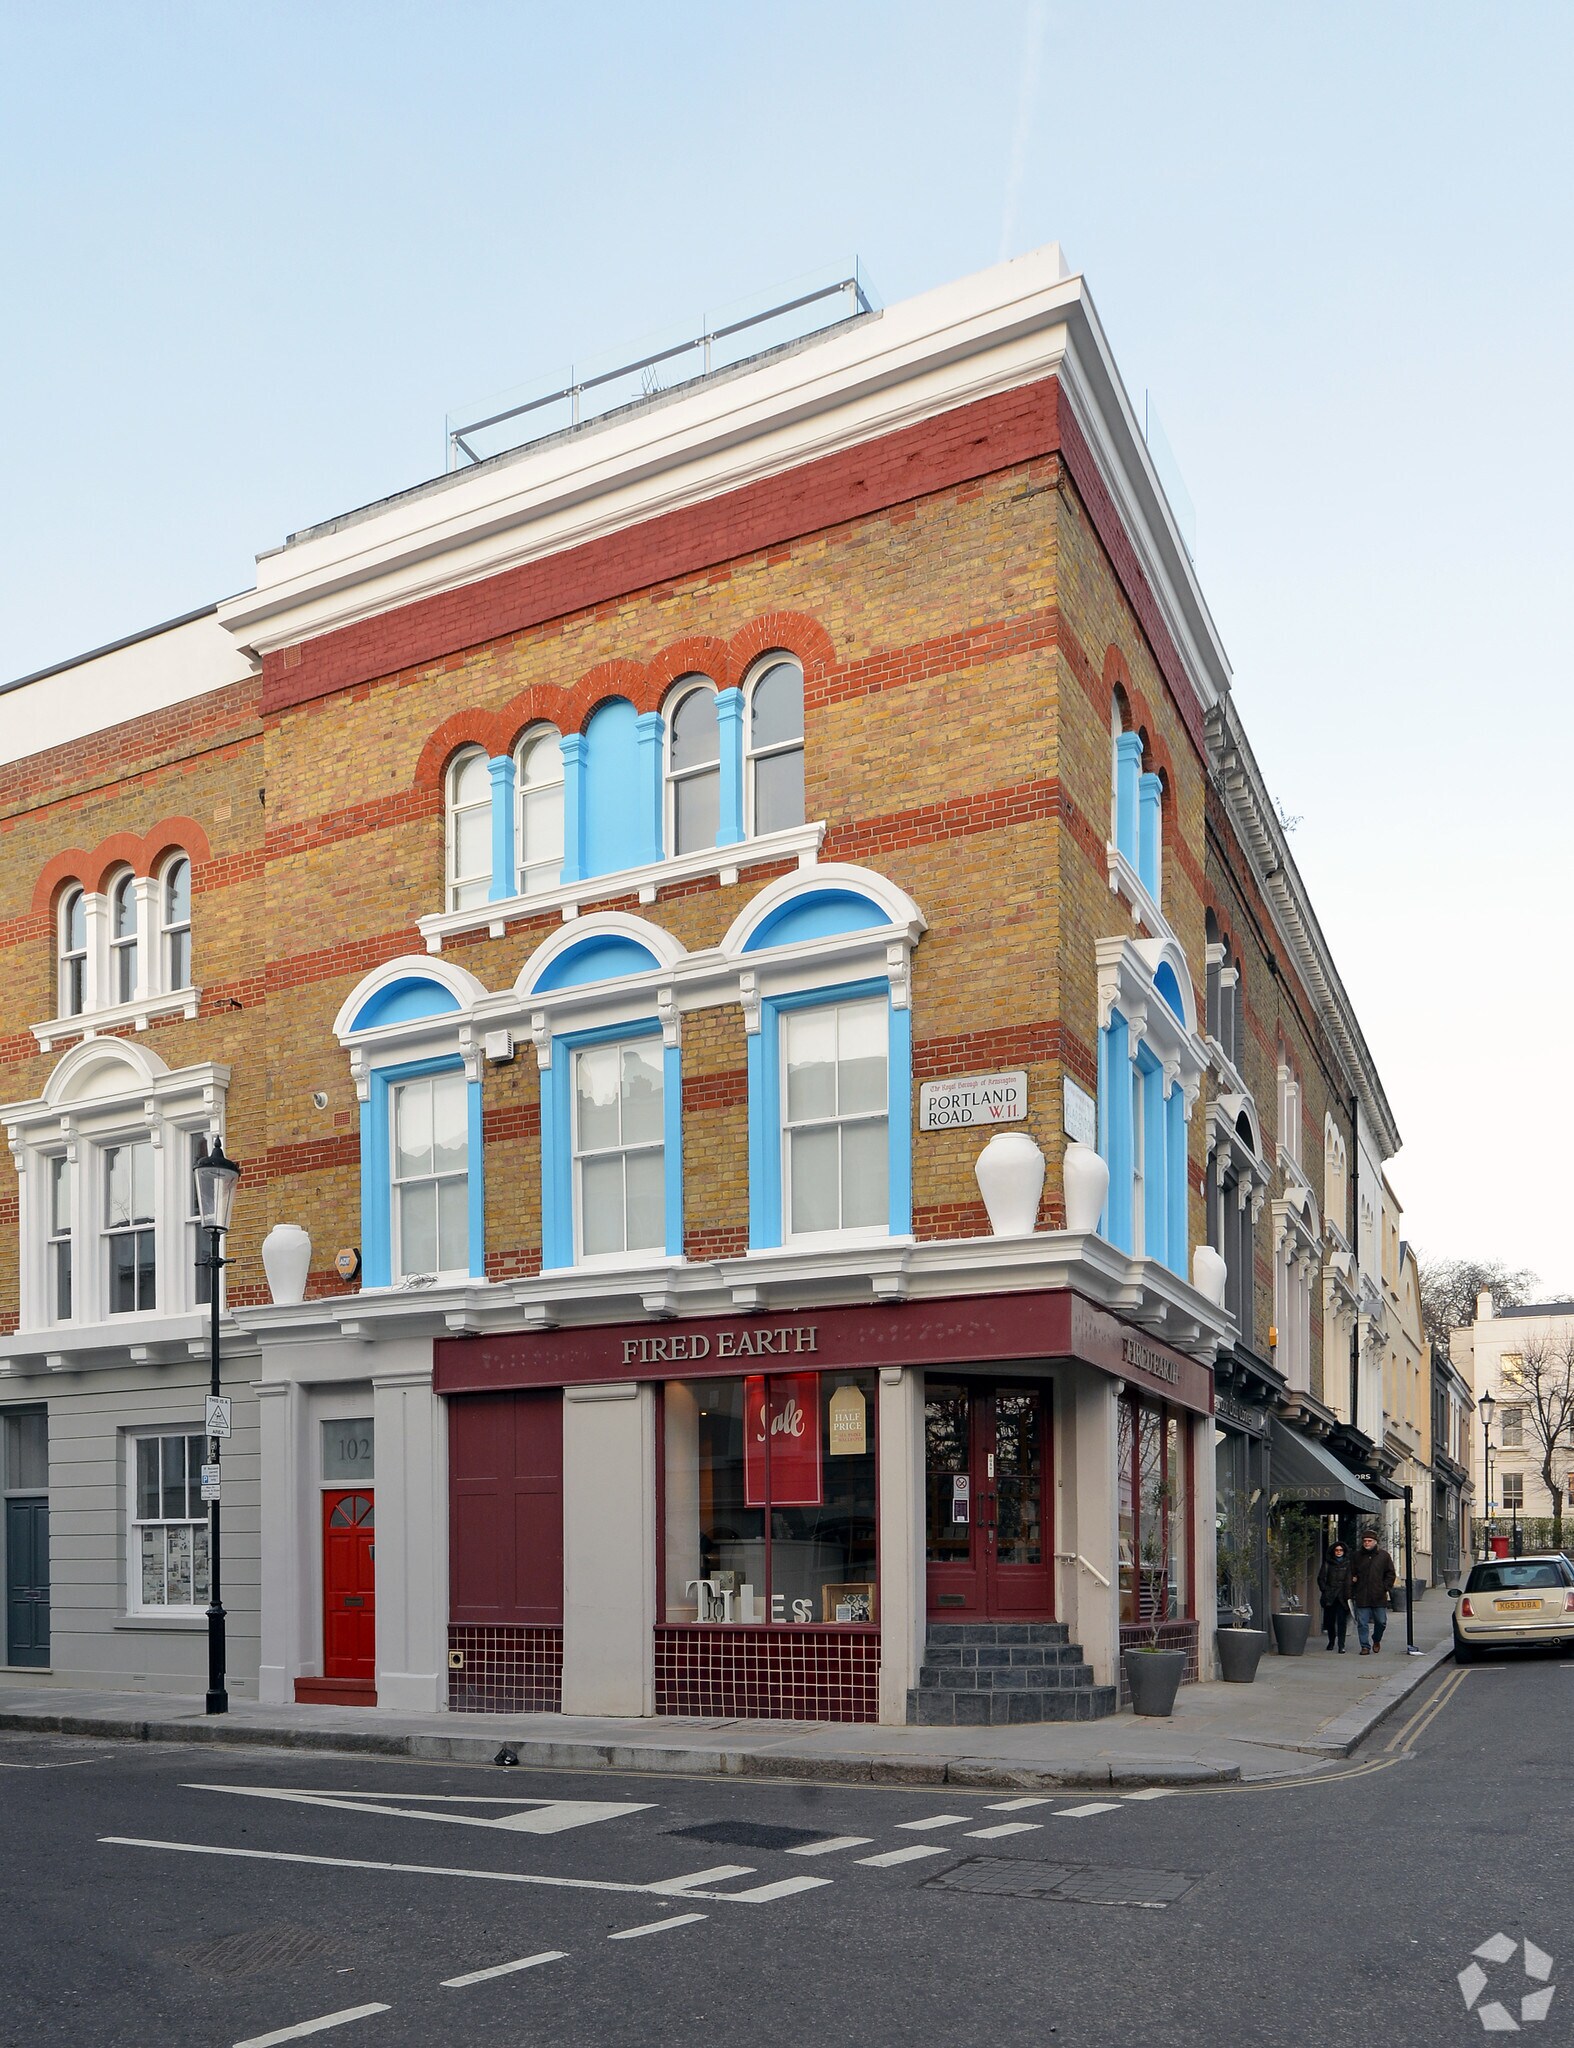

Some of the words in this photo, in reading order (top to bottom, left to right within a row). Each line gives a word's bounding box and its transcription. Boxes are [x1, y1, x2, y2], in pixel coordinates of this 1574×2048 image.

[930, 1085, 941, 1093] The
[942, 1083, 956, 1092] Royal
[957, 1081, 979, 1089] Borough
[987, 1077, 1017, 1086] Kensington
[929, 1088, 1017, 1111] PORTLAND
[929, 1108, 975, 1126] ROAD.
[621, 1334, 710, 1364] FIRED
[716, 1326, 818, 1358] EARTH
[757, 1399, 805, 1442] Sale
[833, 1422, 863, 1431] PRICE
[835, 1413, 861, 1422] HALF
[338, 1438, 370, 1461] 102
[685, 1580, 813, 1624] TILES
